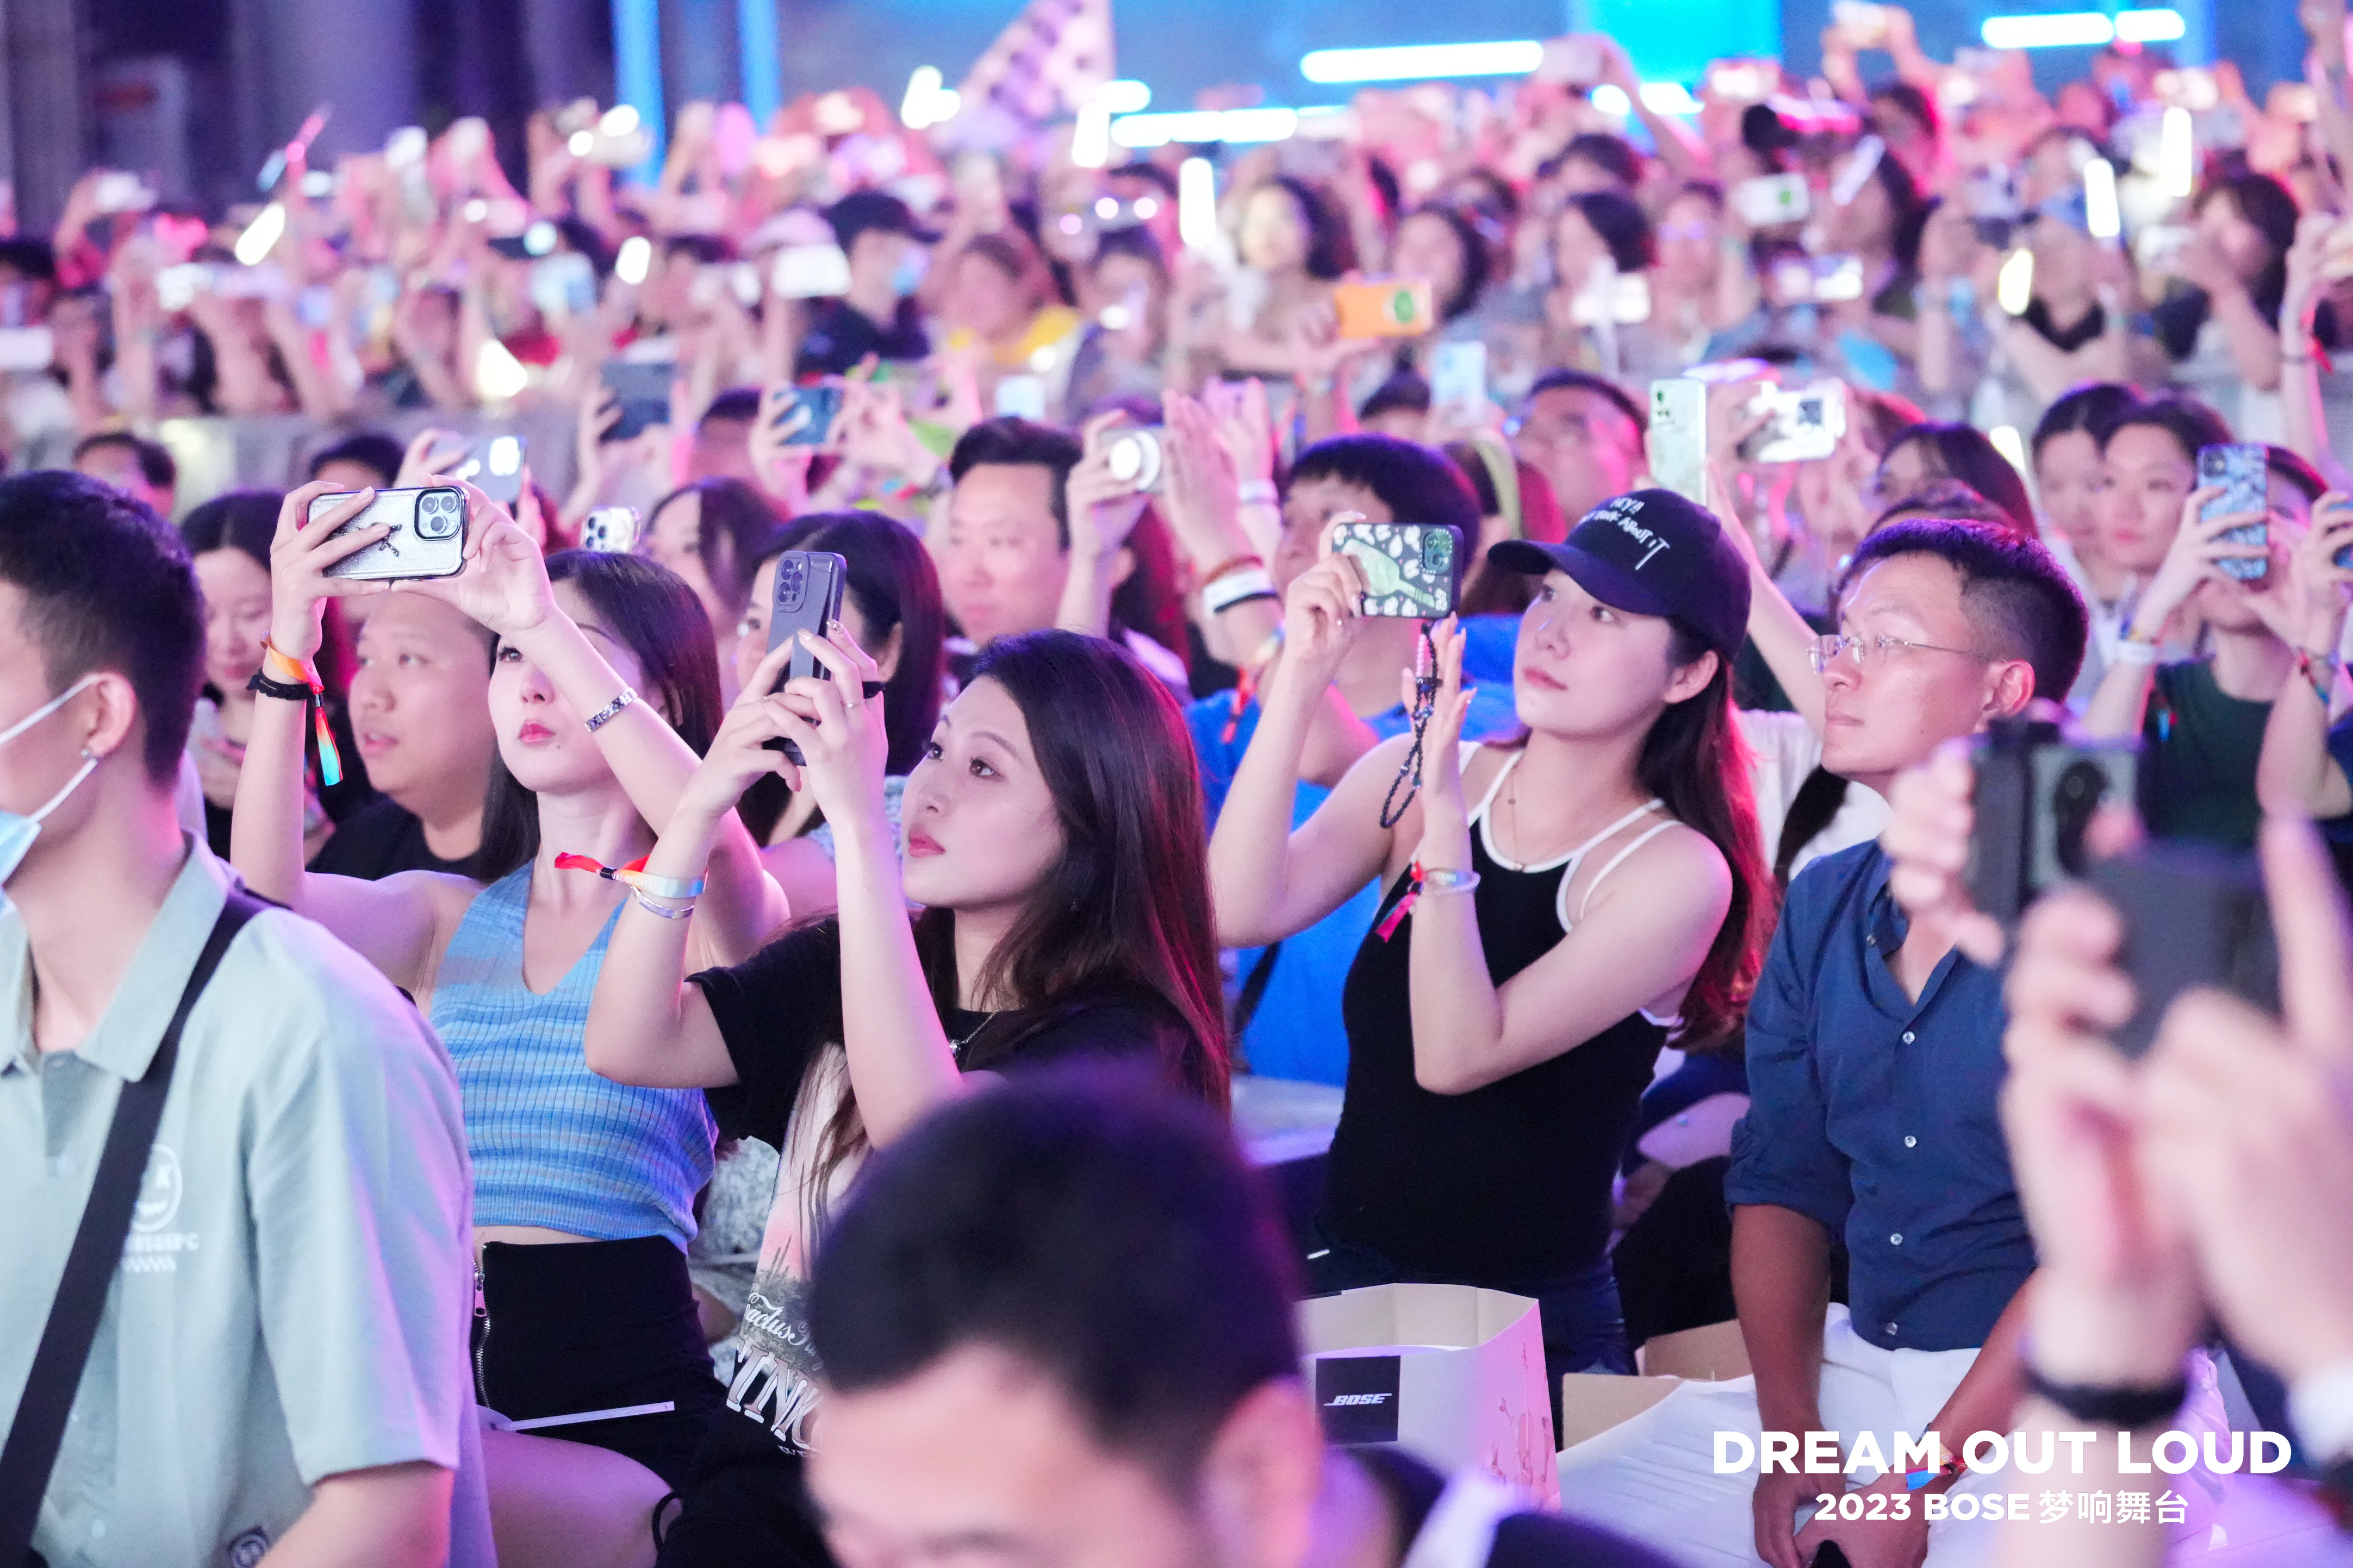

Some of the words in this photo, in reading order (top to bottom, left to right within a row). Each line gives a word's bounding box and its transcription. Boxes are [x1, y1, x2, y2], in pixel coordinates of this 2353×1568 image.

[625, 876, 634, 884] OF
[635, 878, 664, 890] DREAMS
[1323, 1393, 1392, 1407] BOSE
